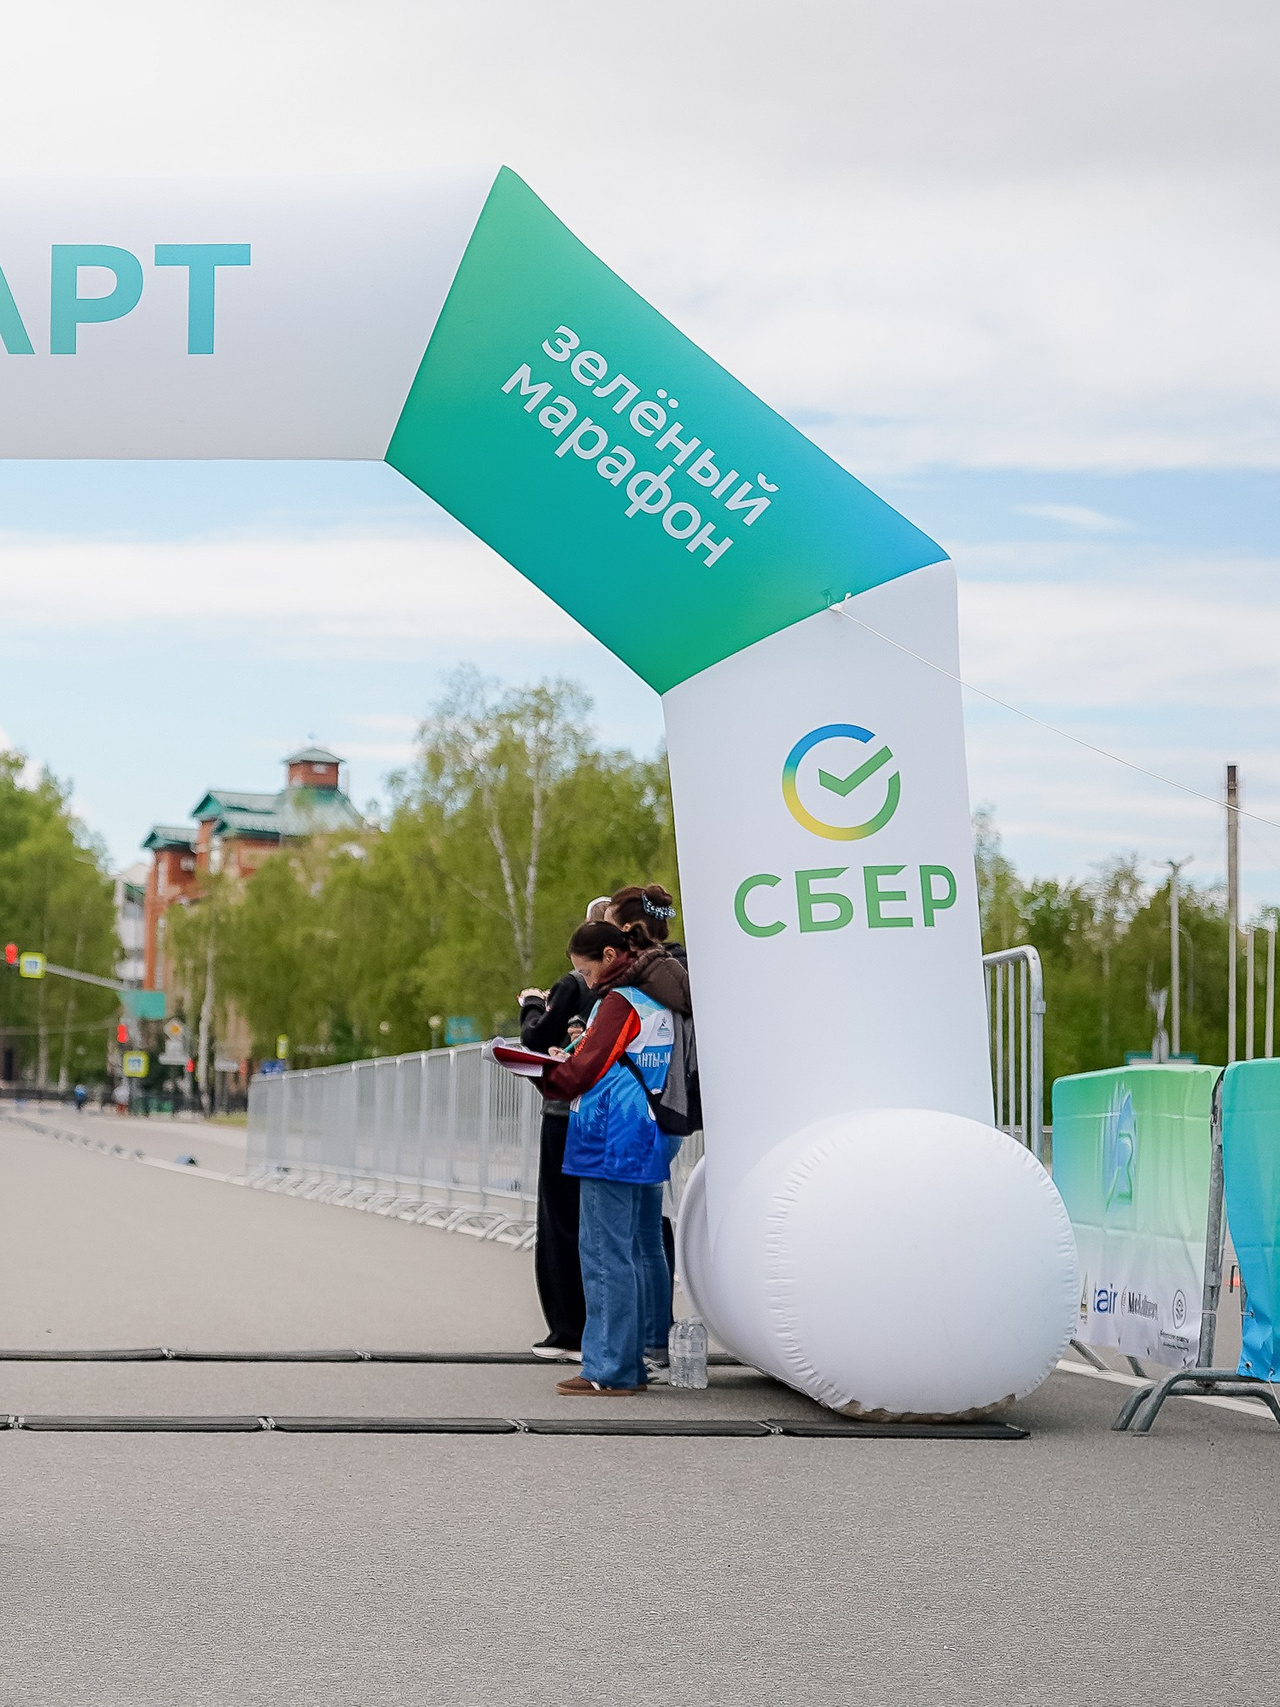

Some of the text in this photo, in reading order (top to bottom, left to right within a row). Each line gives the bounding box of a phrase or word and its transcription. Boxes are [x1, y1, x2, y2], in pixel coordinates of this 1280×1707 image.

[500, 362, 734, 568] марафон
[541, 324, 780, 527] зелёный
[734, 864, 958, 938] СБЕР
